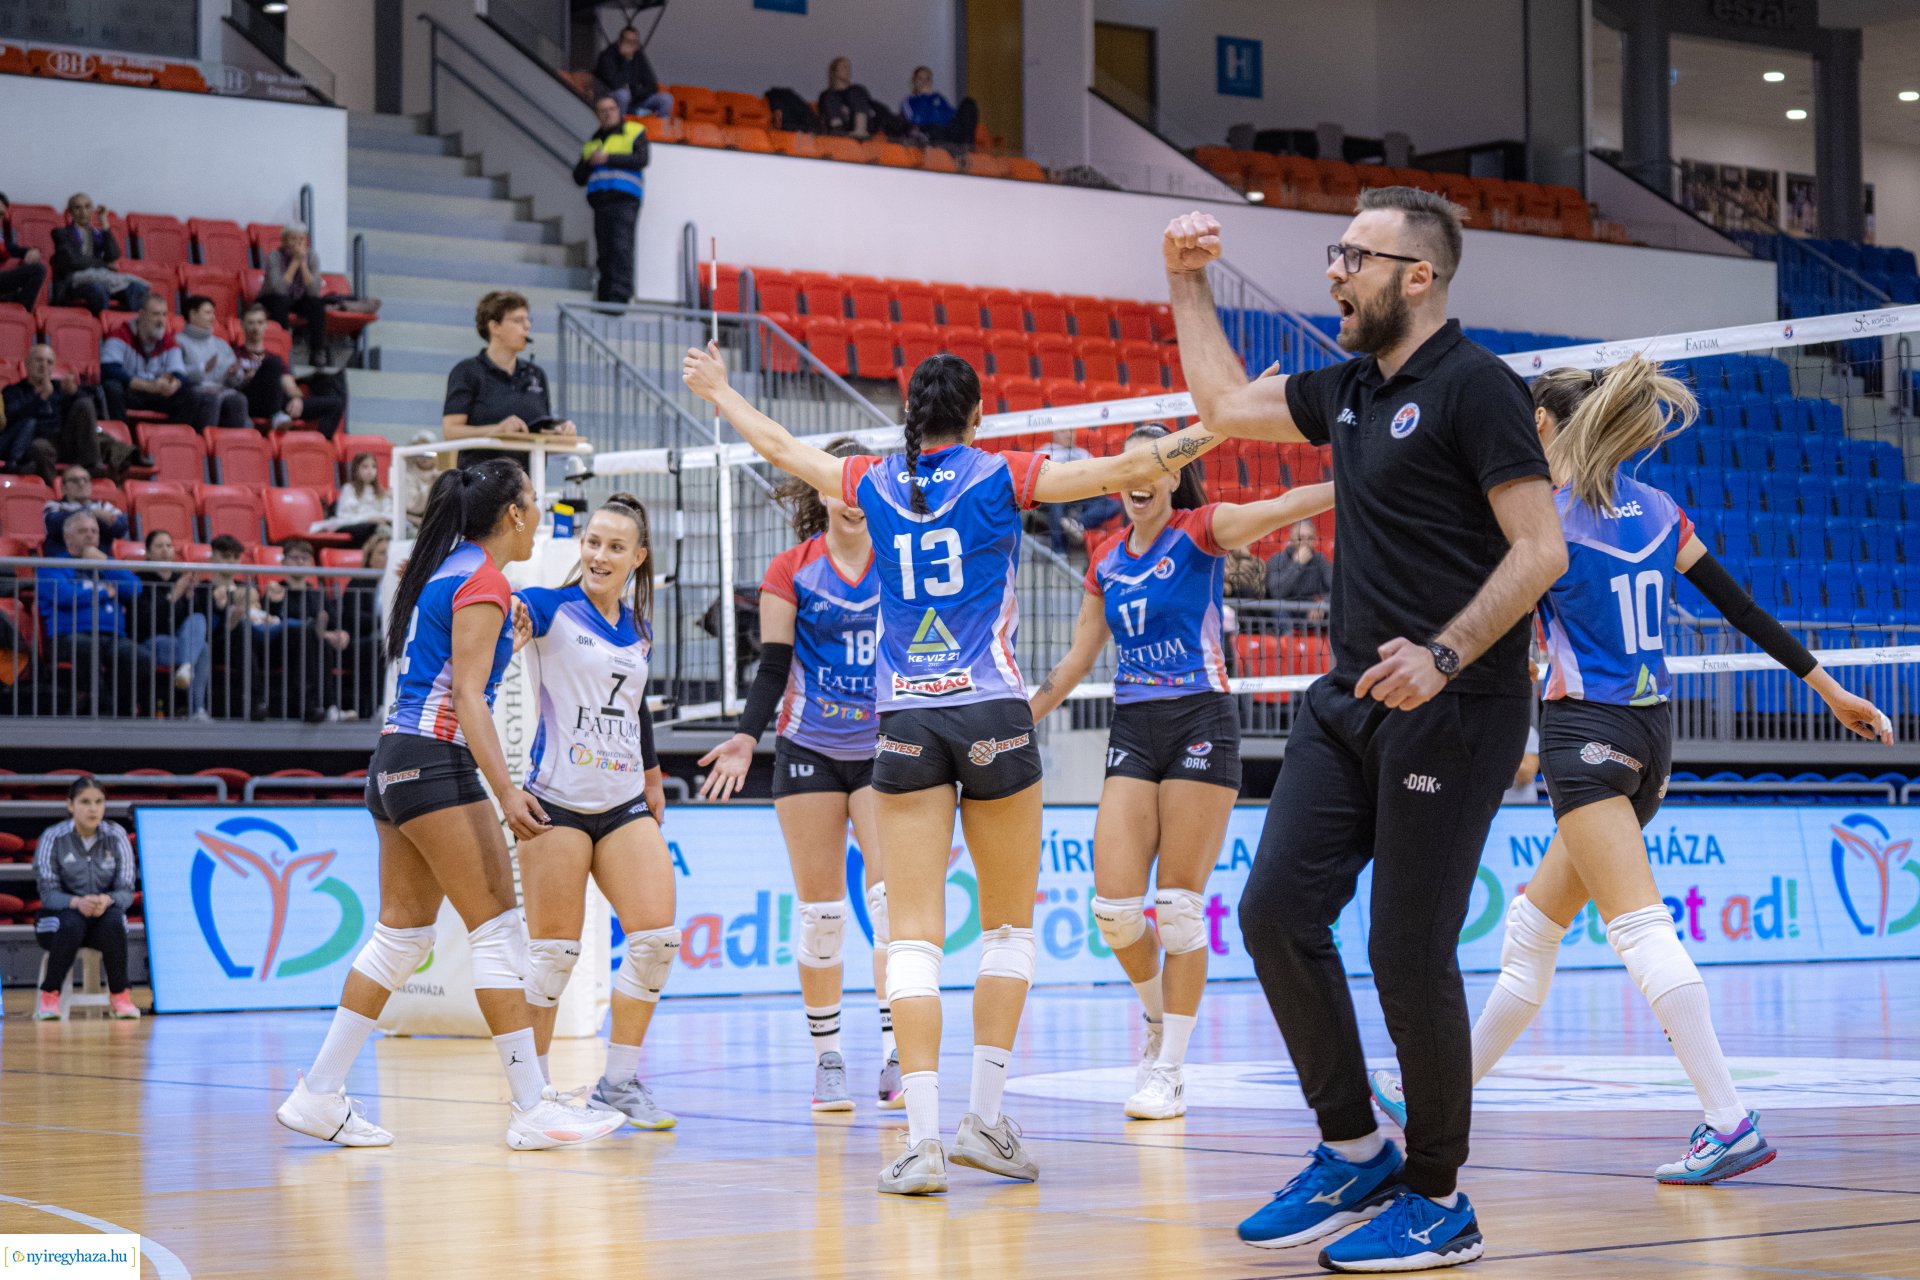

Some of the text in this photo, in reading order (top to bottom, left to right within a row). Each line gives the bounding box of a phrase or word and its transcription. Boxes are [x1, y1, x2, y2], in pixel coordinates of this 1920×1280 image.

[893, 527, 965, 600] 13
[1118, 597, 1147, 638] 17
[1610, 570, 1664, 654] 10
[842, 629, 876, 666] 18
[607, 672, 628, 706] 7
[573, 704, 640, 740] FATUM
[679, 889, 793, 969] ad!
[1721, 875, 1800, 941] ad!
